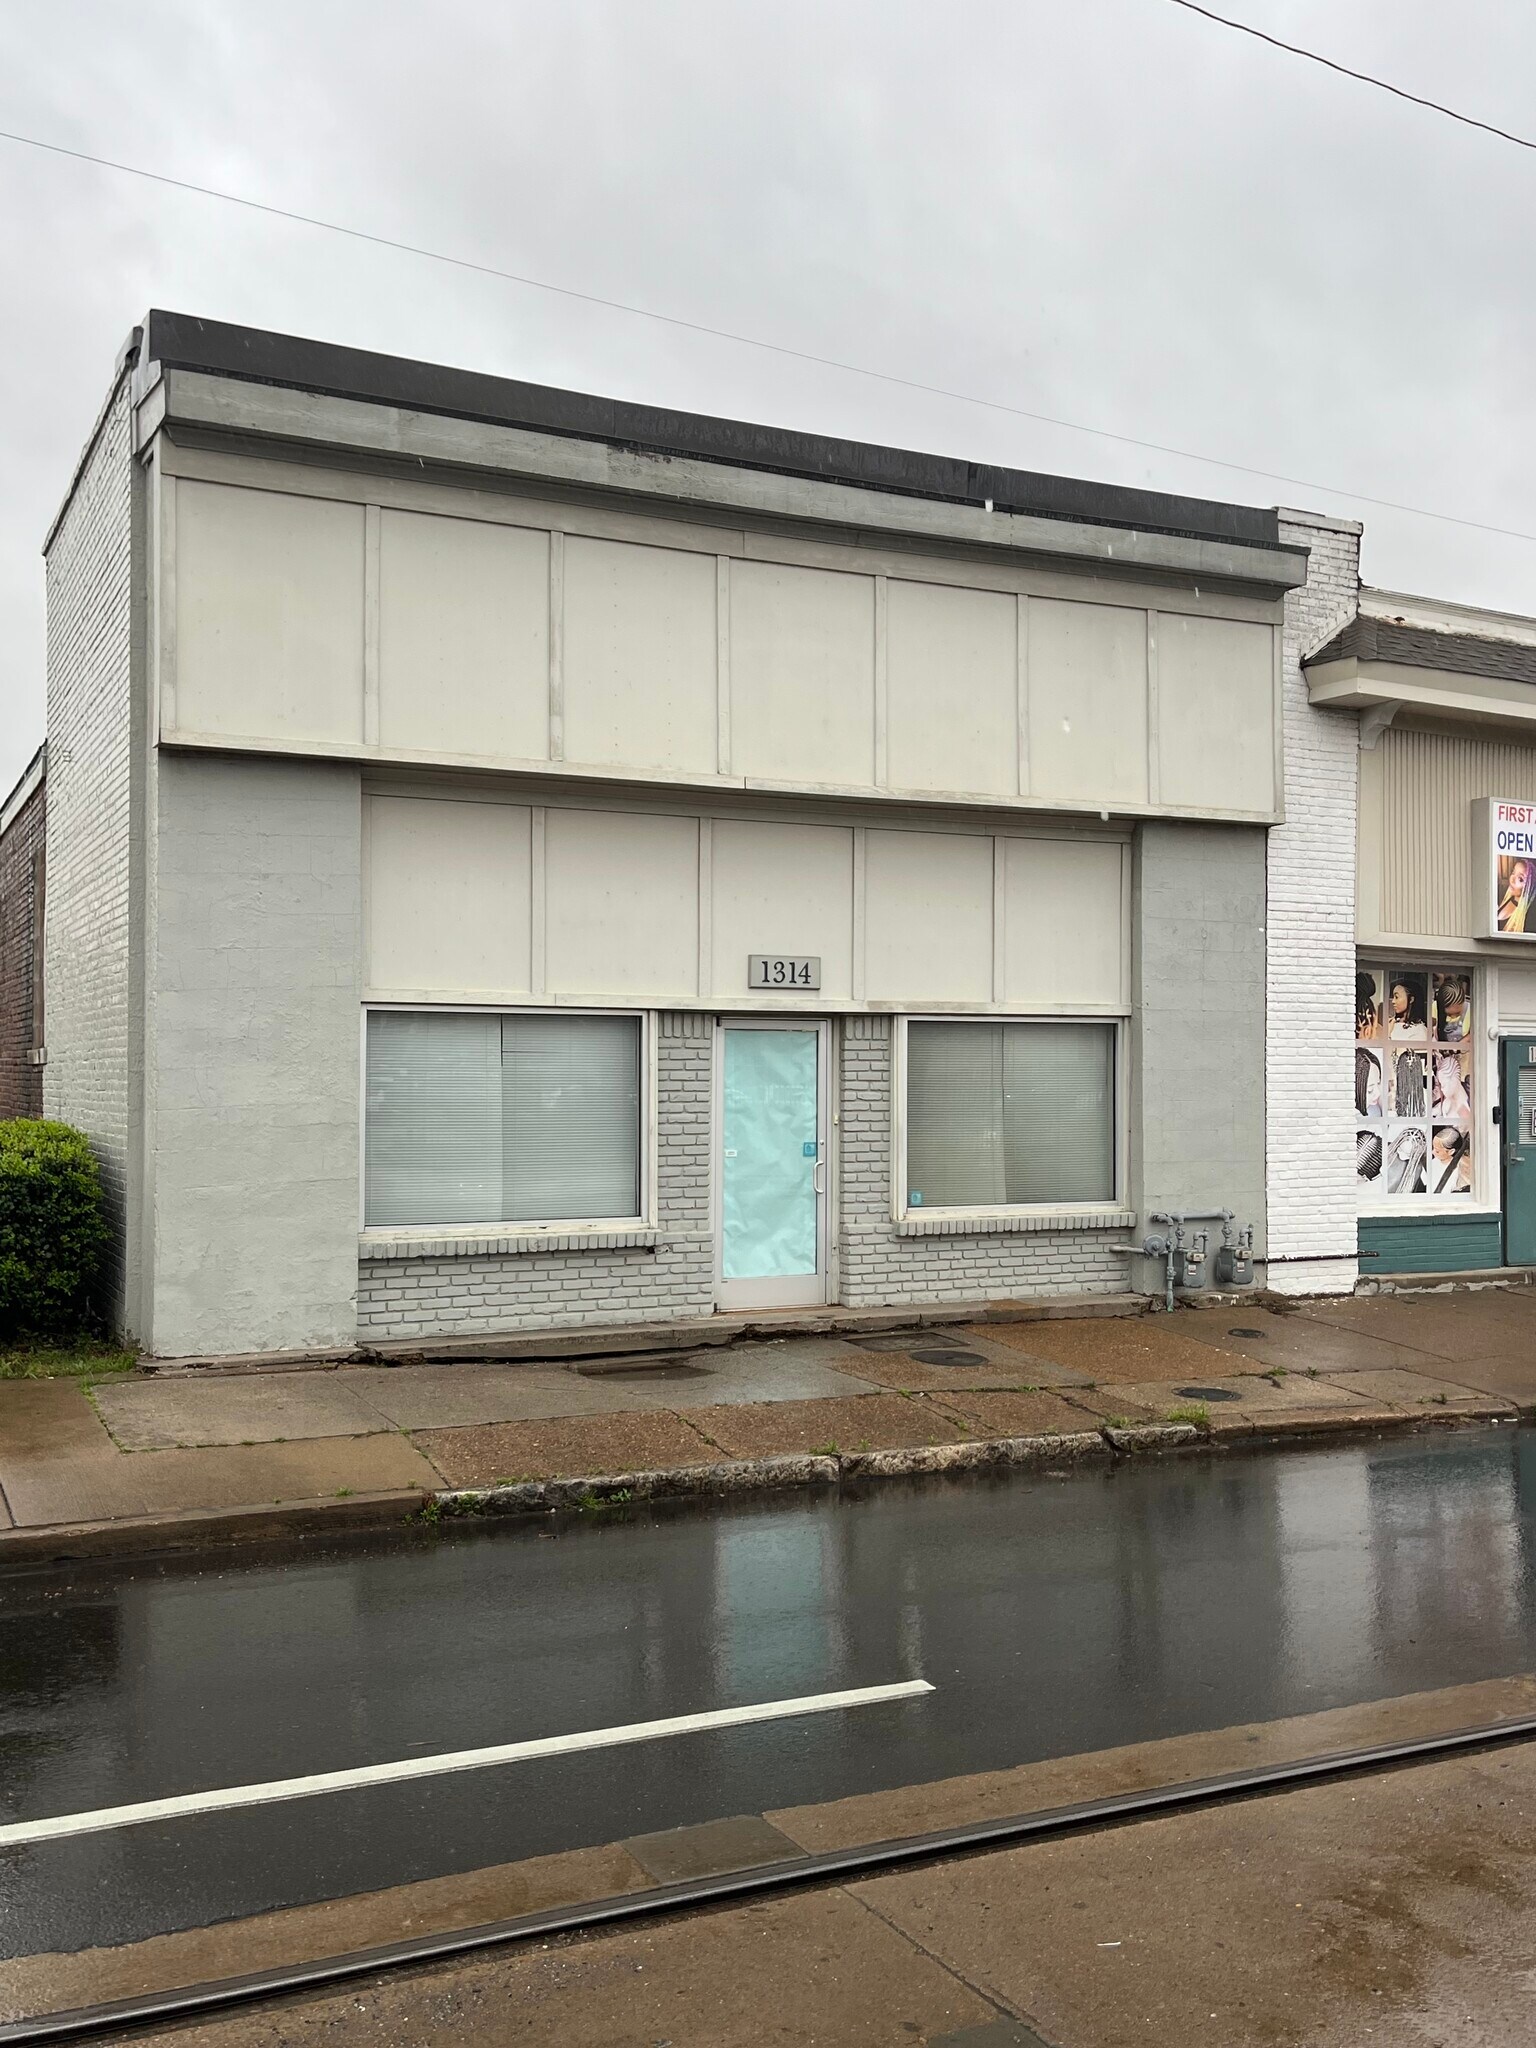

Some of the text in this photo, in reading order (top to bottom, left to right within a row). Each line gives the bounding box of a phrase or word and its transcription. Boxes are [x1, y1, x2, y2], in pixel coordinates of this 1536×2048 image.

[1498, 805, 1534, 824] FIRST
[1497, 830, 1533, 852] OPEN
[761, 960, 812, 984] 1314
